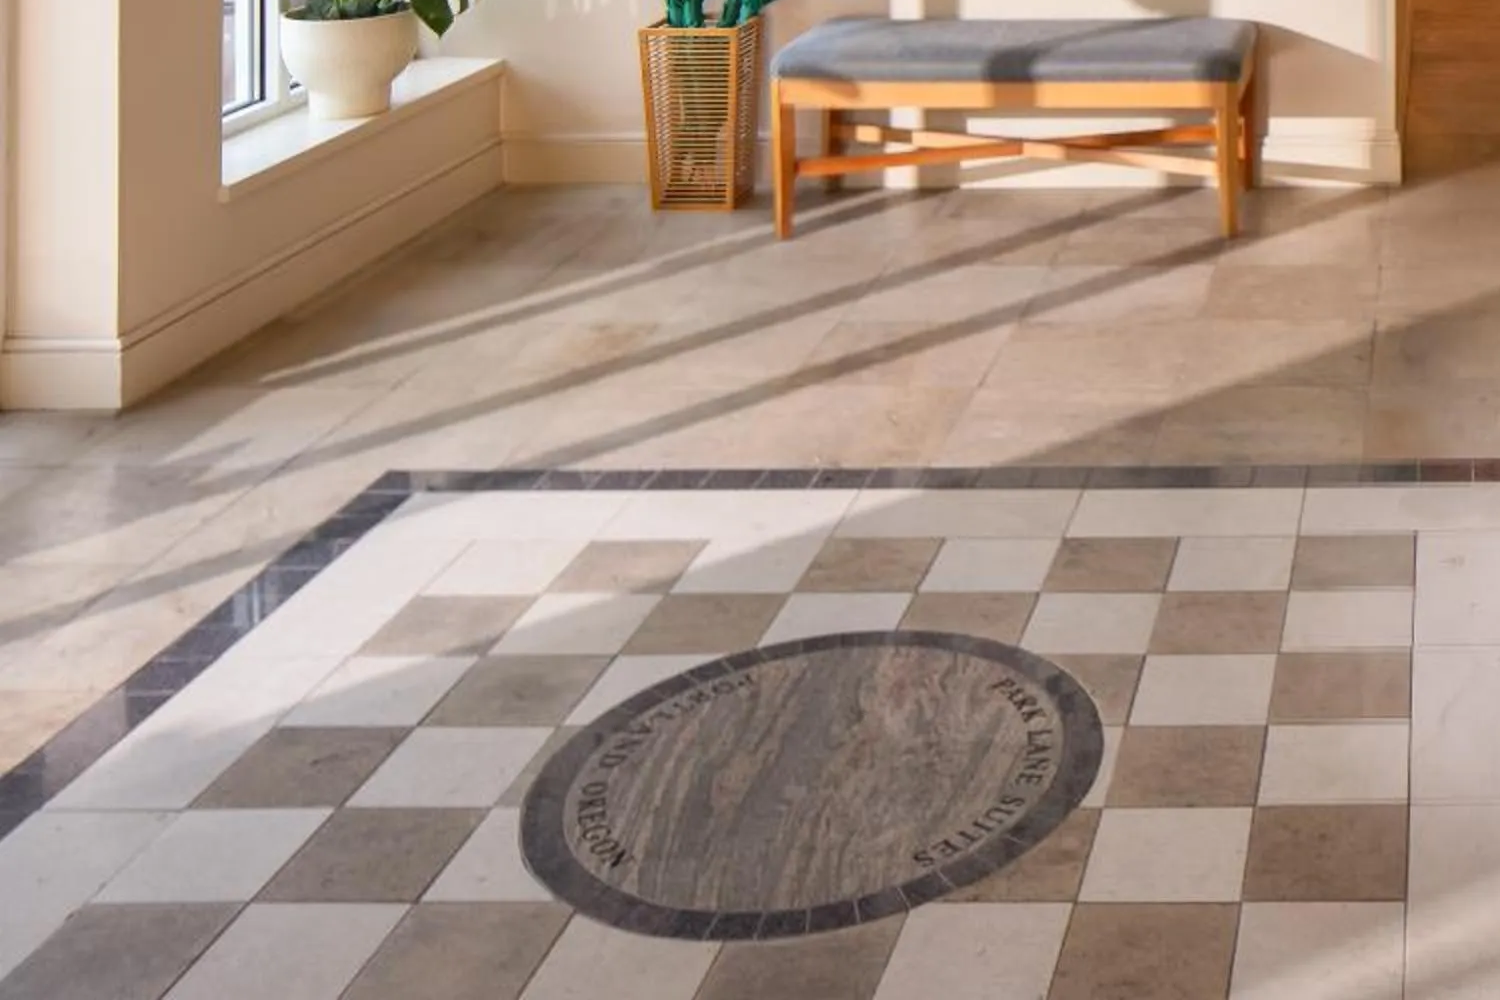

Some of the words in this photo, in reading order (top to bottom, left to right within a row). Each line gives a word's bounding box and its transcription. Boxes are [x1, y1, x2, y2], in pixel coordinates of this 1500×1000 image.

[988, 678, 1048, 723] PARK
[1014, 728, 1053, 786] LANE
[578, 781, 634, 869] OREGON
[912, 796, 1025, 868] SUITES
